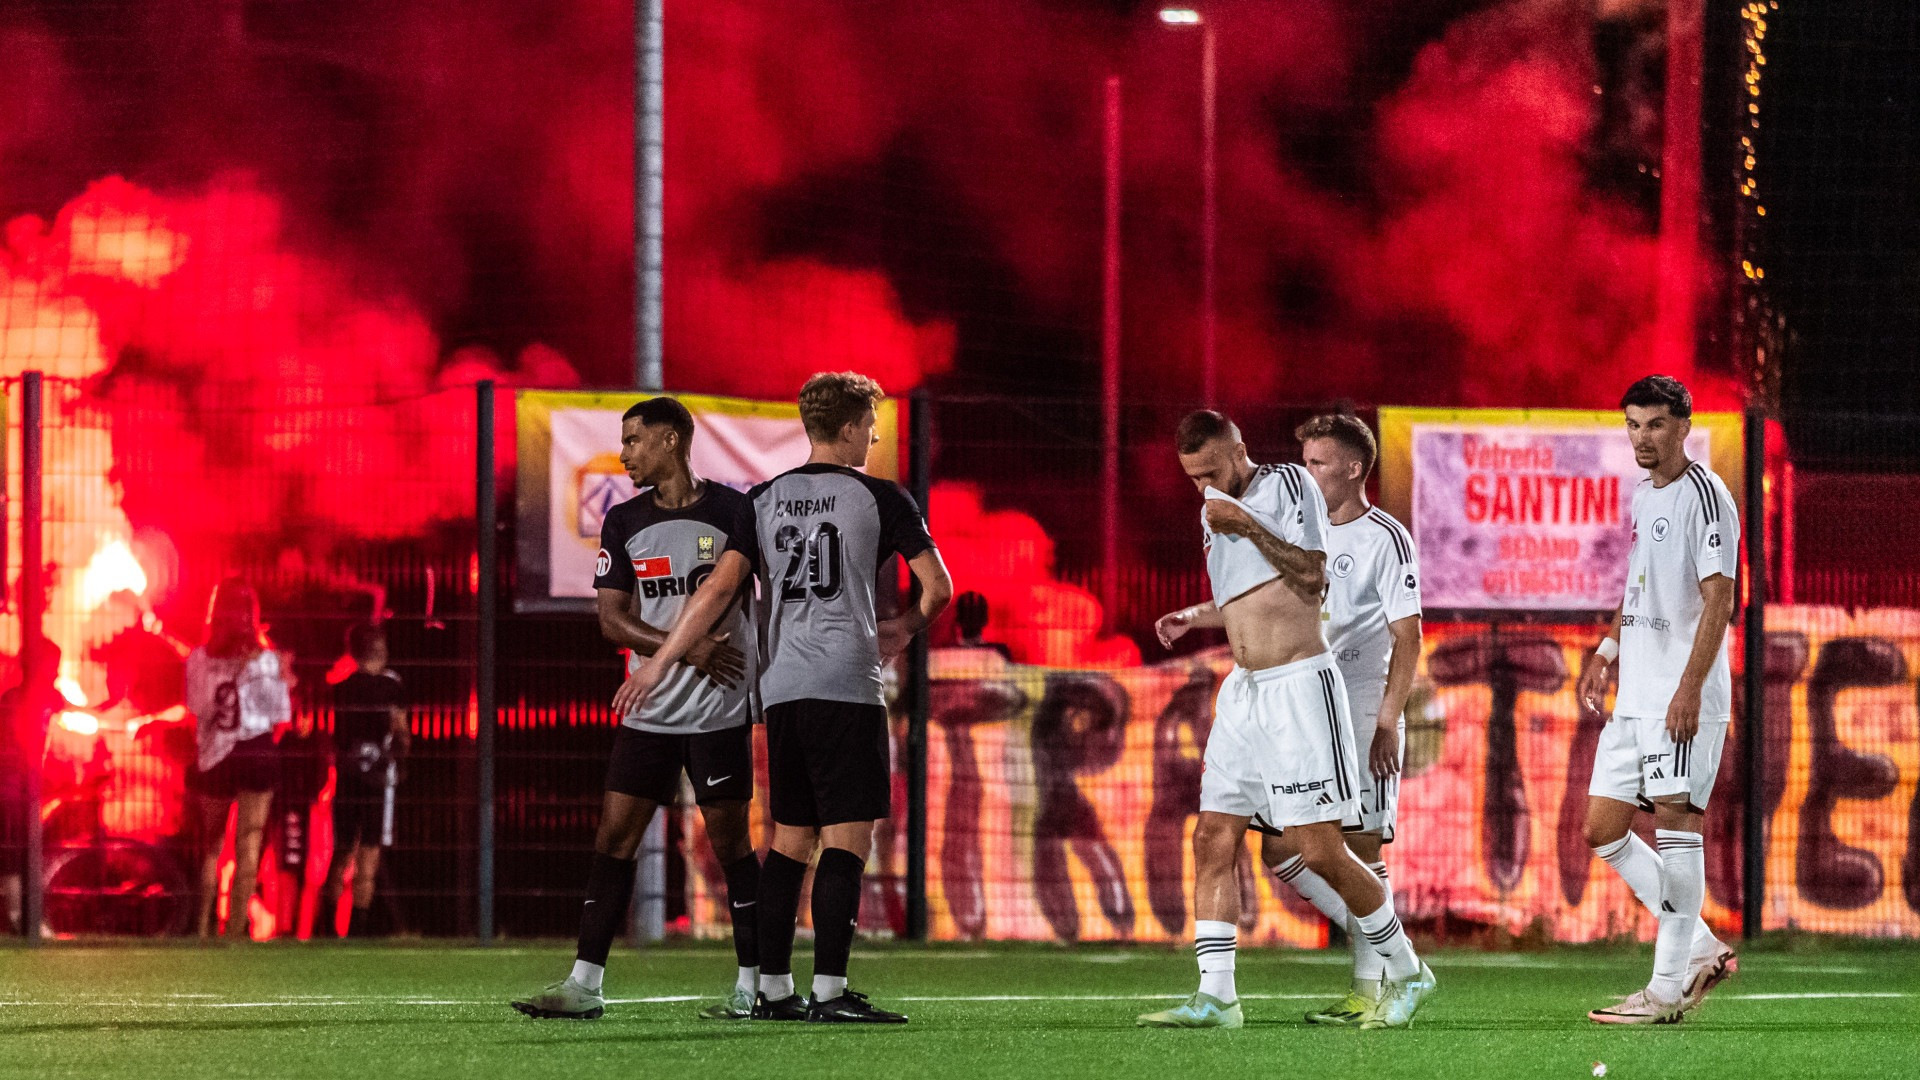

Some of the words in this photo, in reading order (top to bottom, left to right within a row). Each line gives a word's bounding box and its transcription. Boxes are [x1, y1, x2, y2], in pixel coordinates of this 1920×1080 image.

[777, 496, 836, 517] CARPANI
[1465, 474, 1619, 525] SANTINI
[775, 522, 843, 603] 20
[1271, 778, 1334, 796] halter
